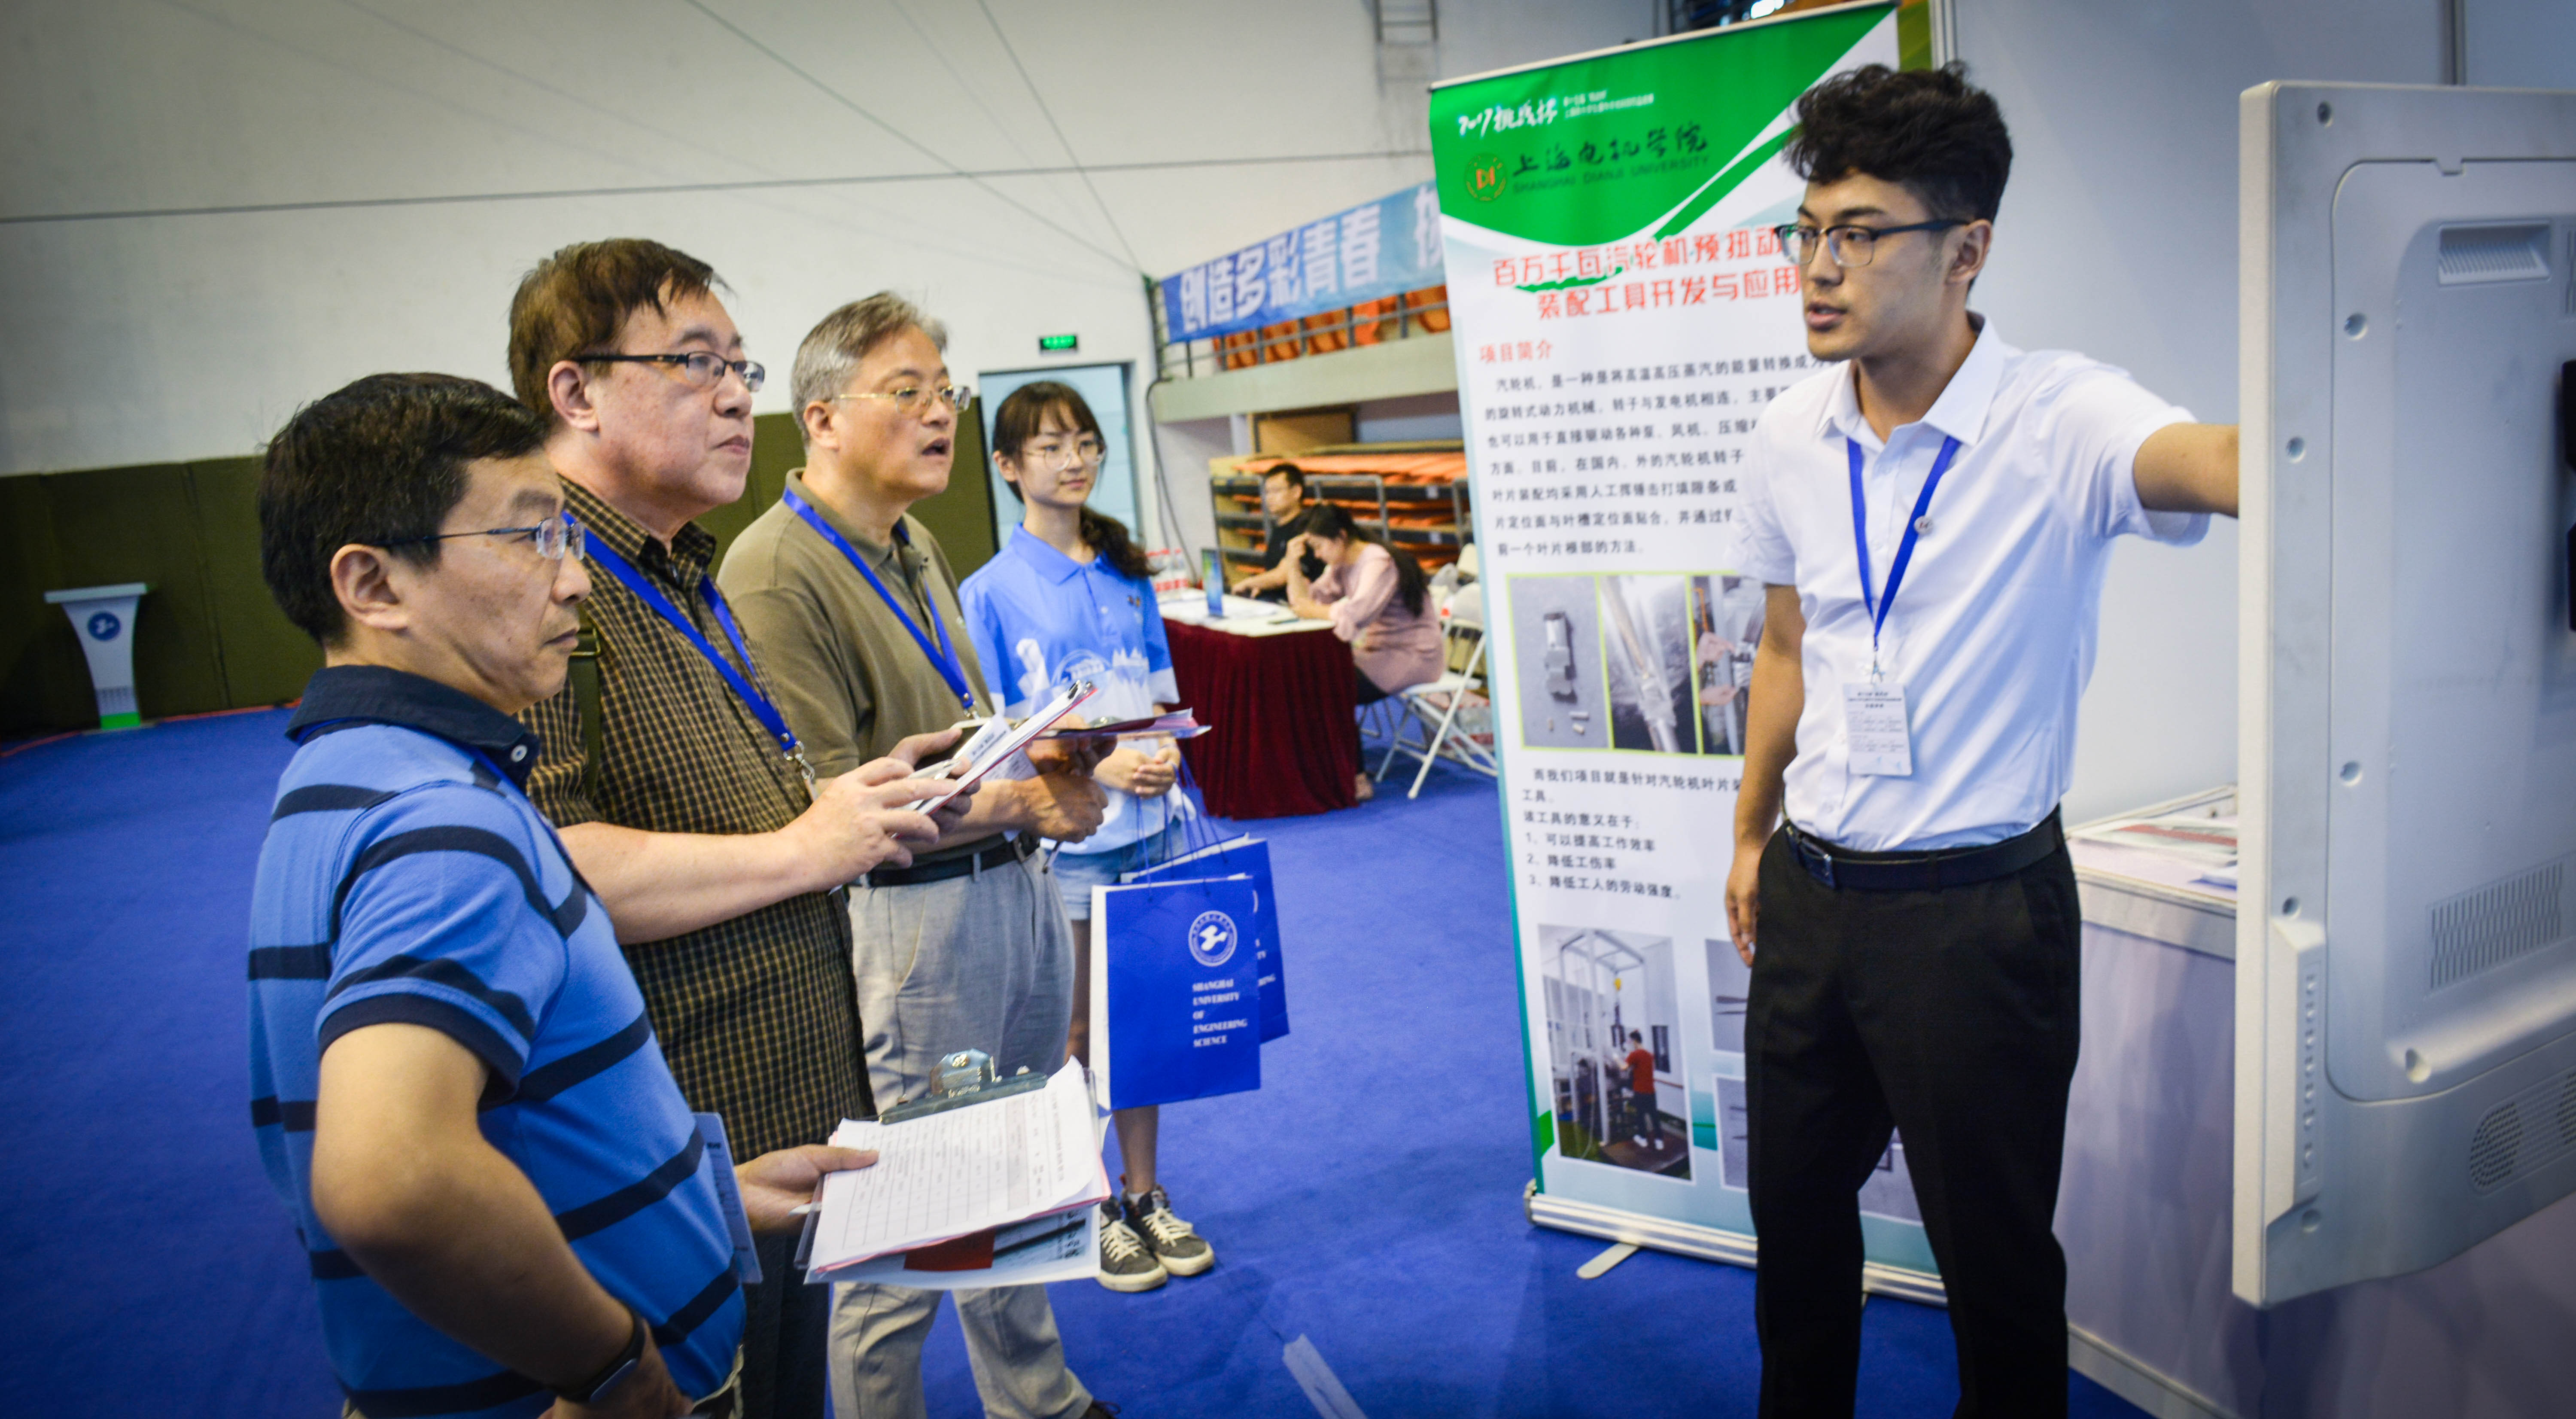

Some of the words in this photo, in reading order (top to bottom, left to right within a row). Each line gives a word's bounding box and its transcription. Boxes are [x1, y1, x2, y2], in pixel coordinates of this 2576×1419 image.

[1631, 155, 1709, 177] UNIVERSITY
[1180, 204, 1381, 333] 创造多彩青春
[1538, 264, 1801, 320] 装配工具开发与应用
[1480, 338, 1553, 364] 项目简介
[1192, 978, 1234, 992] SHANGHAI
[1192, 992, 1240, 1006] UNIVERSITY
[1192, 1010, 1205, 1020] OF
[1193, 1018, 1248, 1034] ENGINEERING
[1193, 1035, 1227, 1048] SCIENCE
